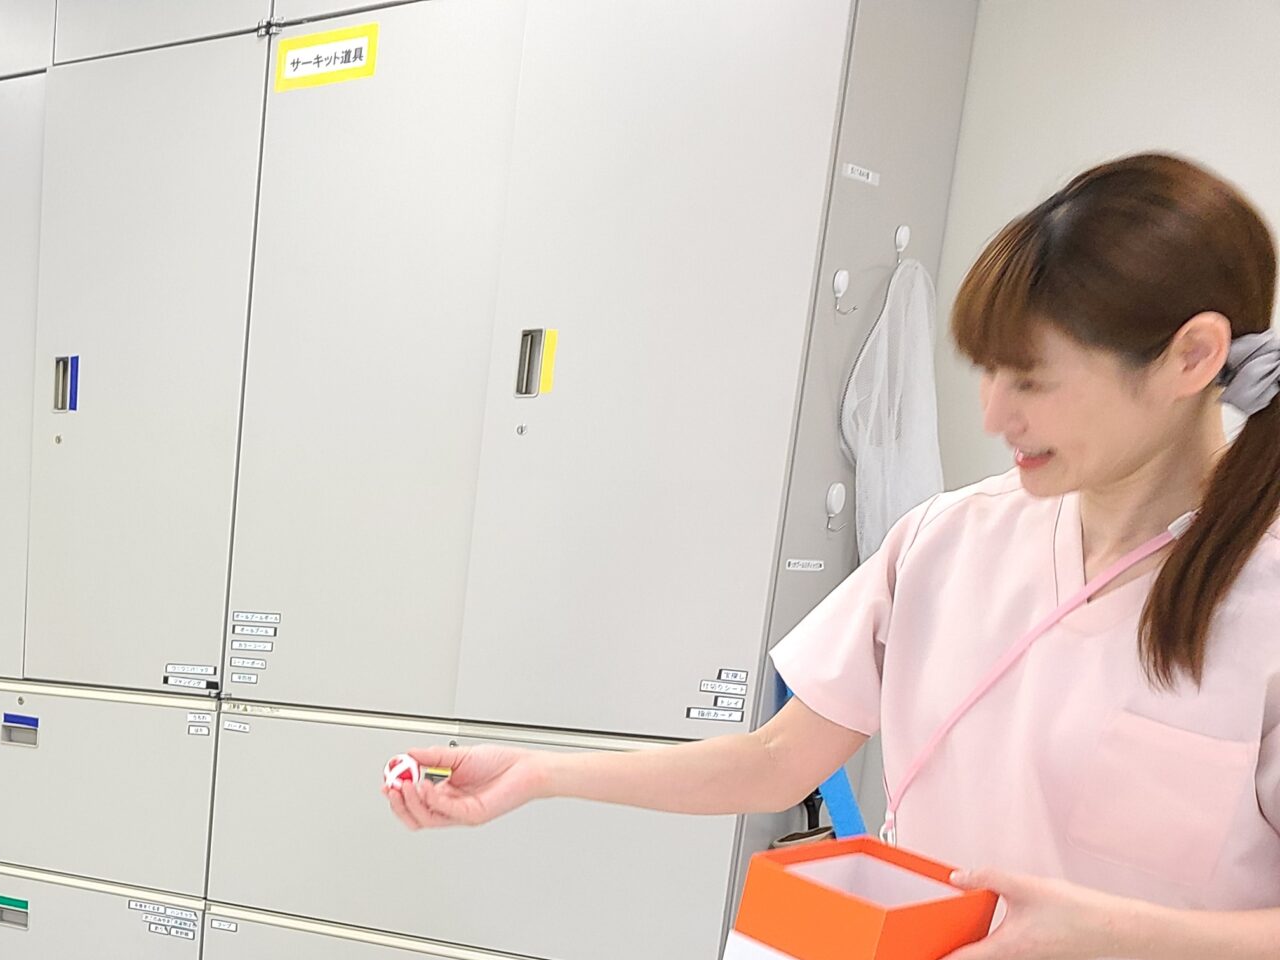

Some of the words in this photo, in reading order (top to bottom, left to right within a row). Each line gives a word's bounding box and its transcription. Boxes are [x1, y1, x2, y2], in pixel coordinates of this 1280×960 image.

[290, 46, 364, 72] サーキット道具
[702, 682, 745, 693] 仕切りシート
[719, 699, 740, 707] トレイ
[697, 709, 734, 719] 指示カード
